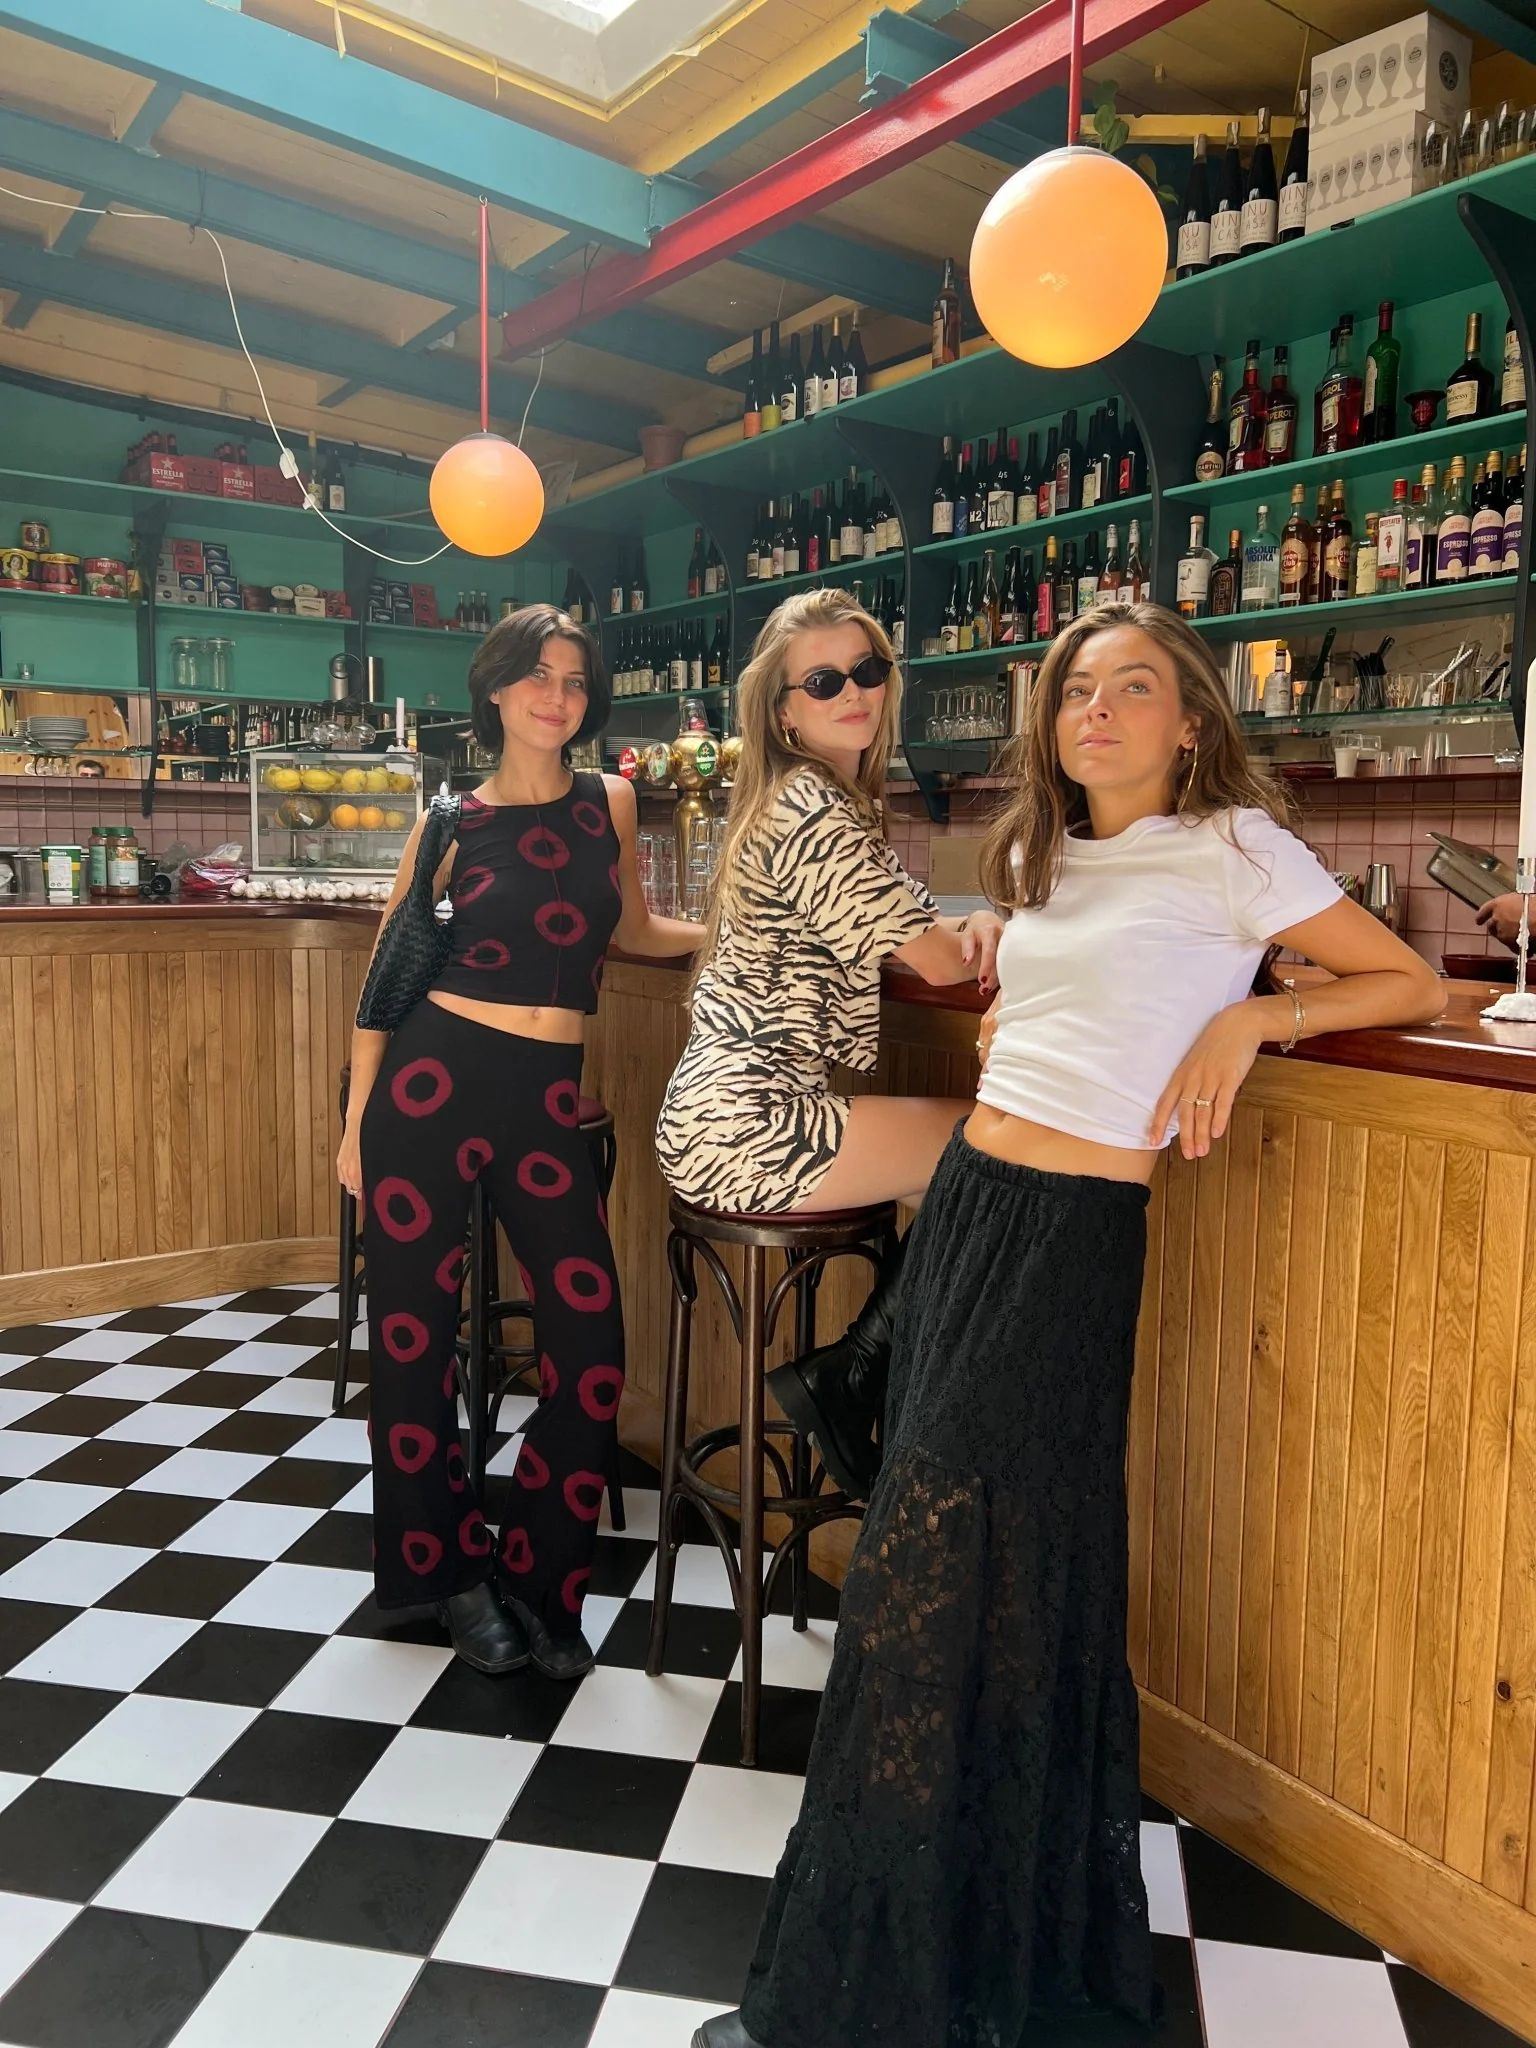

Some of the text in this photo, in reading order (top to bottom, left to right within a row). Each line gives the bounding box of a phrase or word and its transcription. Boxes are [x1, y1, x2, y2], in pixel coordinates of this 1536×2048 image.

[1212, 213, 1239, 229] VIN
[1218, 229, 1240, 241] CAS
[1269, 409, 1292, 420] PEROL
[1197, 463, 1222, 471] MARTINI
[152, 468, 185, 478] ESTRELLA
[223, 477, 254, 488] ESTRELLA
[1443, 539, 1468, 549] ESPRESSO
[1472, 534, 1498, 545] ESPRESSO
[1245, 545, 1277, 555] ABSOLUT
[1247, 554, 1274, 563] VODKA
[97, 561, 118, 569] MUTTI
